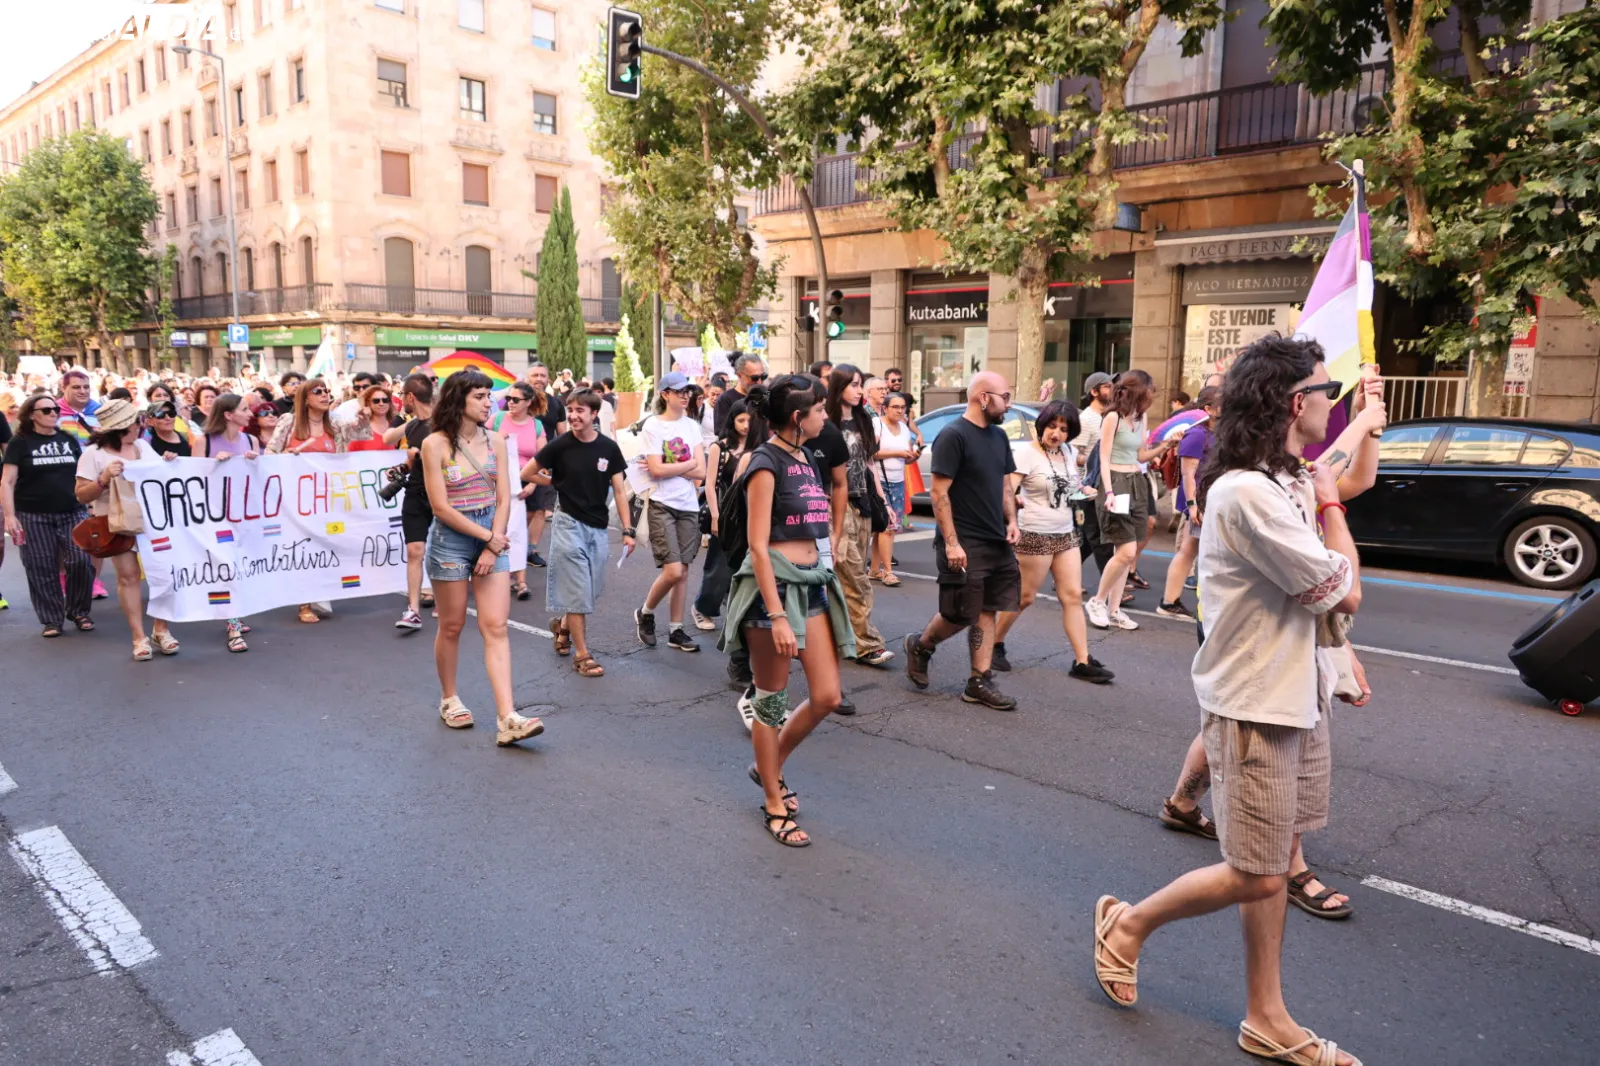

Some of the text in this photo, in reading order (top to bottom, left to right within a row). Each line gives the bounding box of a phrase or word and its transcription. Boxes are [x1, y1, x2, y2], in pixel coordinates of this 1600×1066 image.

[1190, 236, 1332, 258] PACO HERNADE
[1186, 279, 1220, 291] PACO
[909, 303, 979, 320] kutxabank
[1209, 308, 1276, 327] SE VENDE
[232, 326, 245, 341] P
[457, 333, 479, 342] DKV
[1208, 328, 1241, 345] ESTE
[1206, 347, 1240, 363] LOC
[140, 467, 398, 531] ORGULLO CHARRO
